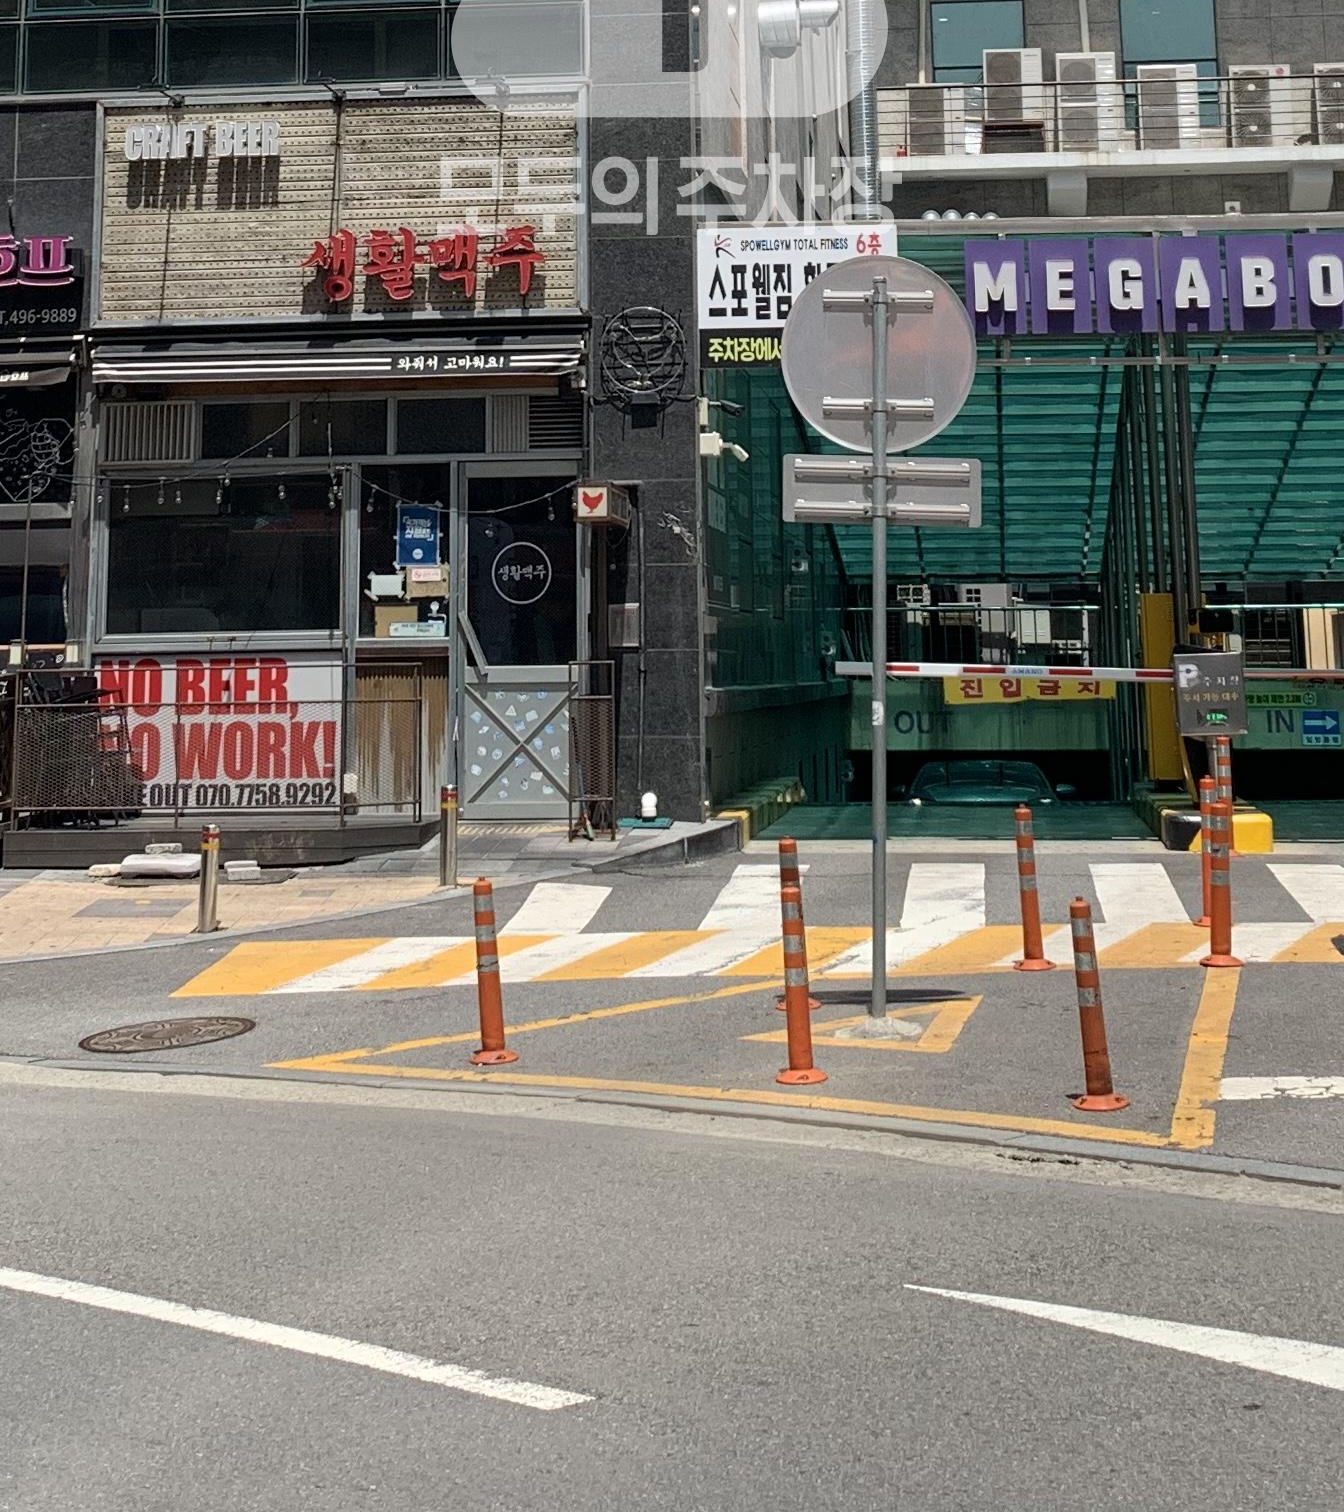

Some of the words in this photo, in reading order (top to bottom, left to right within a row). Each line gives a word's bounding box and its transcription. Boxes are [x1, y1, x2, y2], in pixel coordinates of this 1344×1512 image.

[123, 120, 209, 161] CRAFT
[214, 119, 281, 158] BEER
[740, 239, 791, 252] SPOWELLGYM
[792, 238, 819, 251] TOTAL
[820, 237, 849, 251] FITNESS
[299, 223, 546, 302] 생활맥주
[708, 261, 793, 321] 스포웰짐
[497, 564, 547, 582] 생활맥주
[99, 658, 163, 718] NO
[1177, 663, 1200, 688] P
[894, 710, 953, 734] OUT
[1266, 709, 1295, 734] IN
[171, 720, 338, 781] WORK!
[149, 782, 193, 807] OUT
[196, 781, 337, 807] 070.7758.9292
